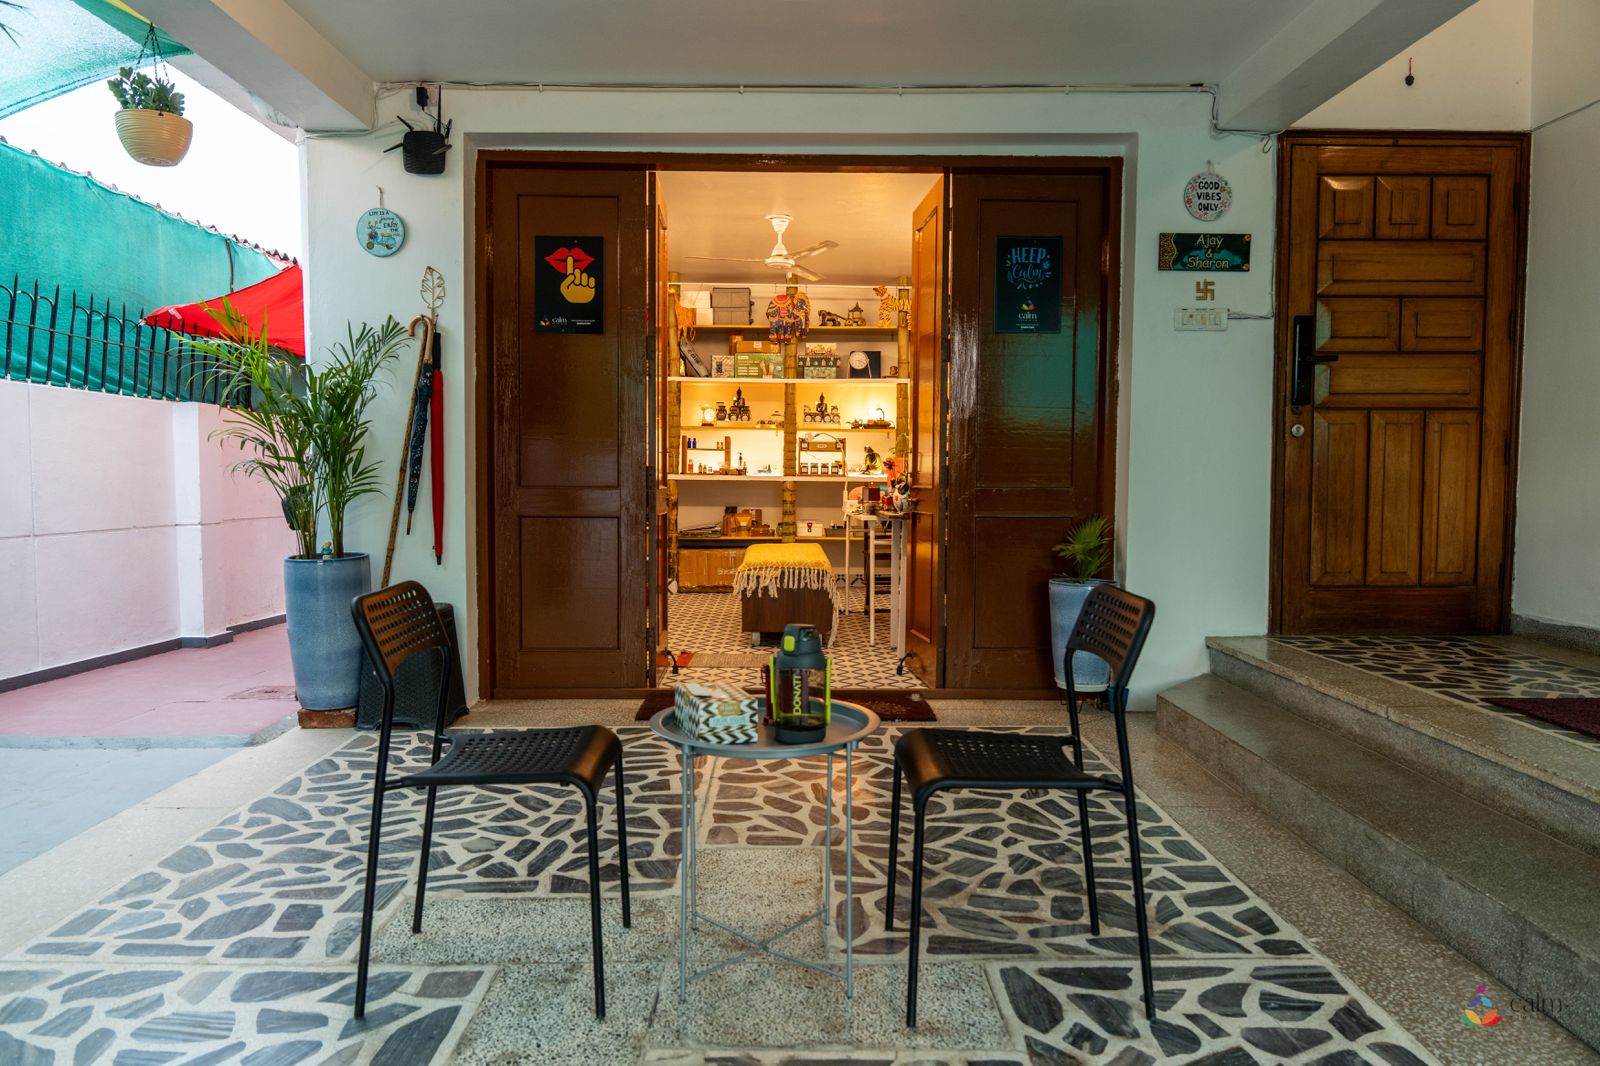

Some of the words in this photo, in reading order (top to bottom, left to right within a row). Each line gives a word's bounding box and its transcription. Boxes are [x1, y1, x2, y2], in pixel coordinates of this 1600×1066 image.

[1198, 181, 1220, 190] GOOD
[1196, 192, 1222, 201] VIBES
[1198, 202, 1219, 211] ONLY
[1196, 234, 1224, 249] Ajay
[1205, 249, 1213, 258] &
[1187, 256, 1229, 269] Sharon
